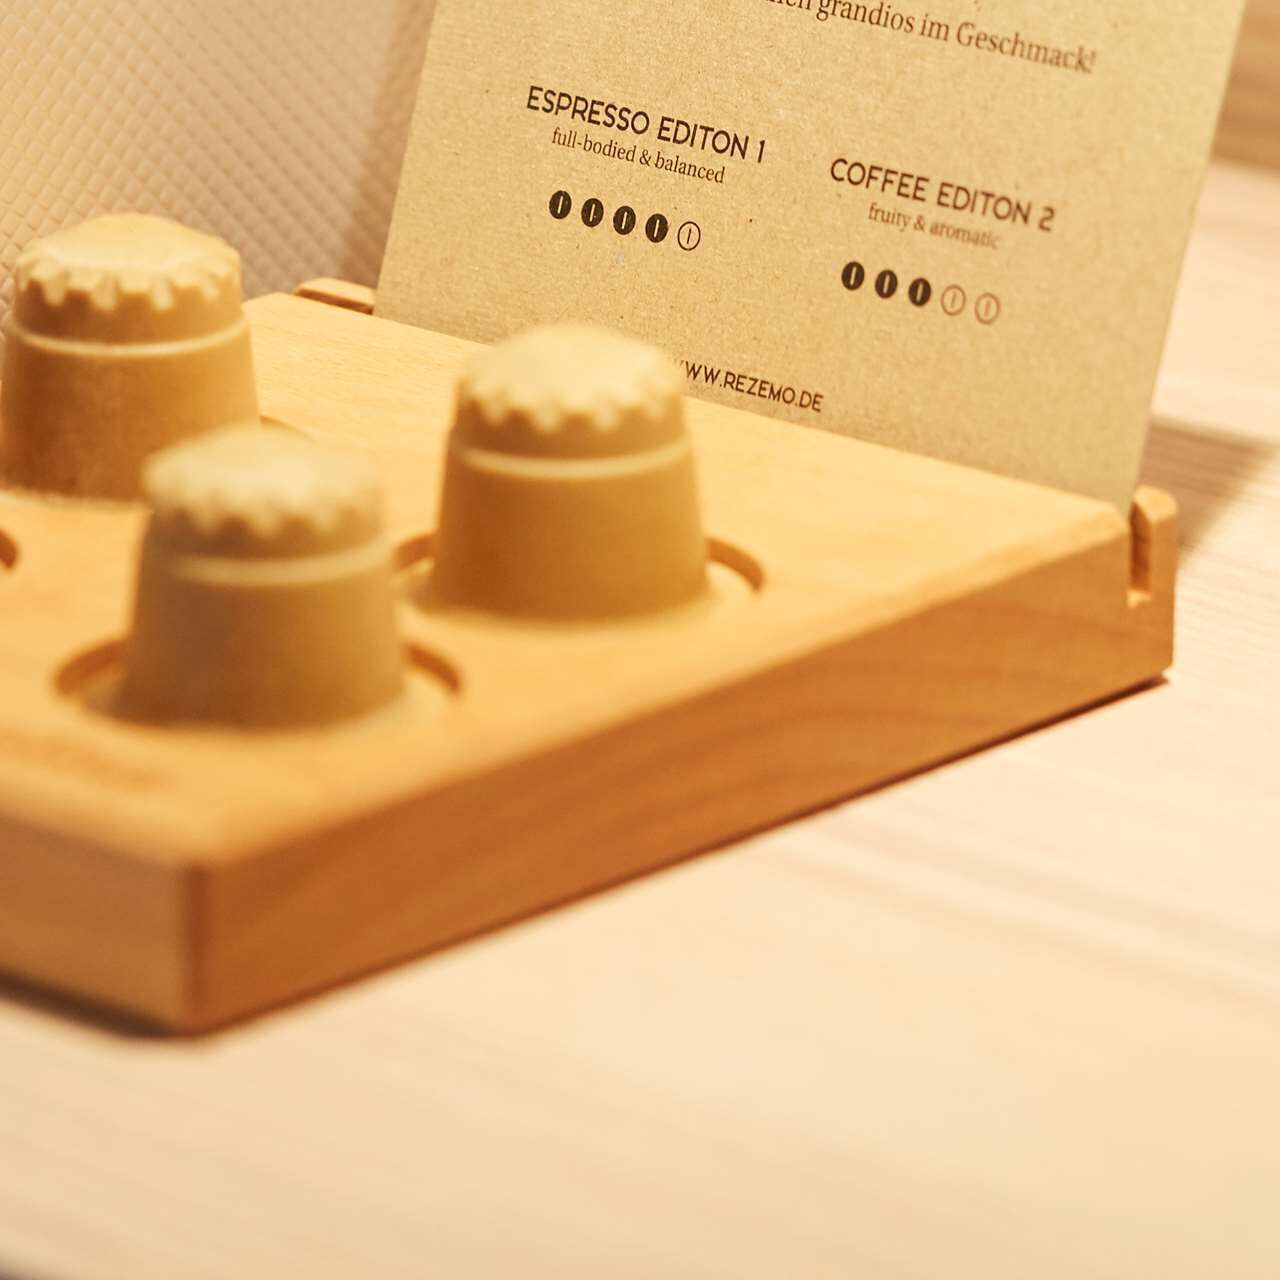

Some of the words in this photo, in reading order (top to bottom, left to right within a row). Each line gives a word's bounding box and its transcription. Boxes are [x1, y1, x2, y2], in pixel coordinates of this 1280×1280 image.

[919, 13, 950, 42] im
[955, 21, 1097, 74] Geschmack!
[526, 85, 650, 135] ESPRESSO
[657, 116, 750, 160] EDITON
[757, 139, 766, 164] 1
[551, 126, 637, 163] full-bodied
[638, 149, 652, 167] &
[654, 150, 726, 184] balanced
[830, 157, 930, 203] COFFEE
[936, 181, 1032, 225] EDITON
[1038, 205, 1056, 233] 2
[867, 202, 911, 232] fruity
[913, 214, 926, 232] &
[929, 222, 1000, 250] aromatic
[679, 359, 824, 413] WW.REZEMO.DE
